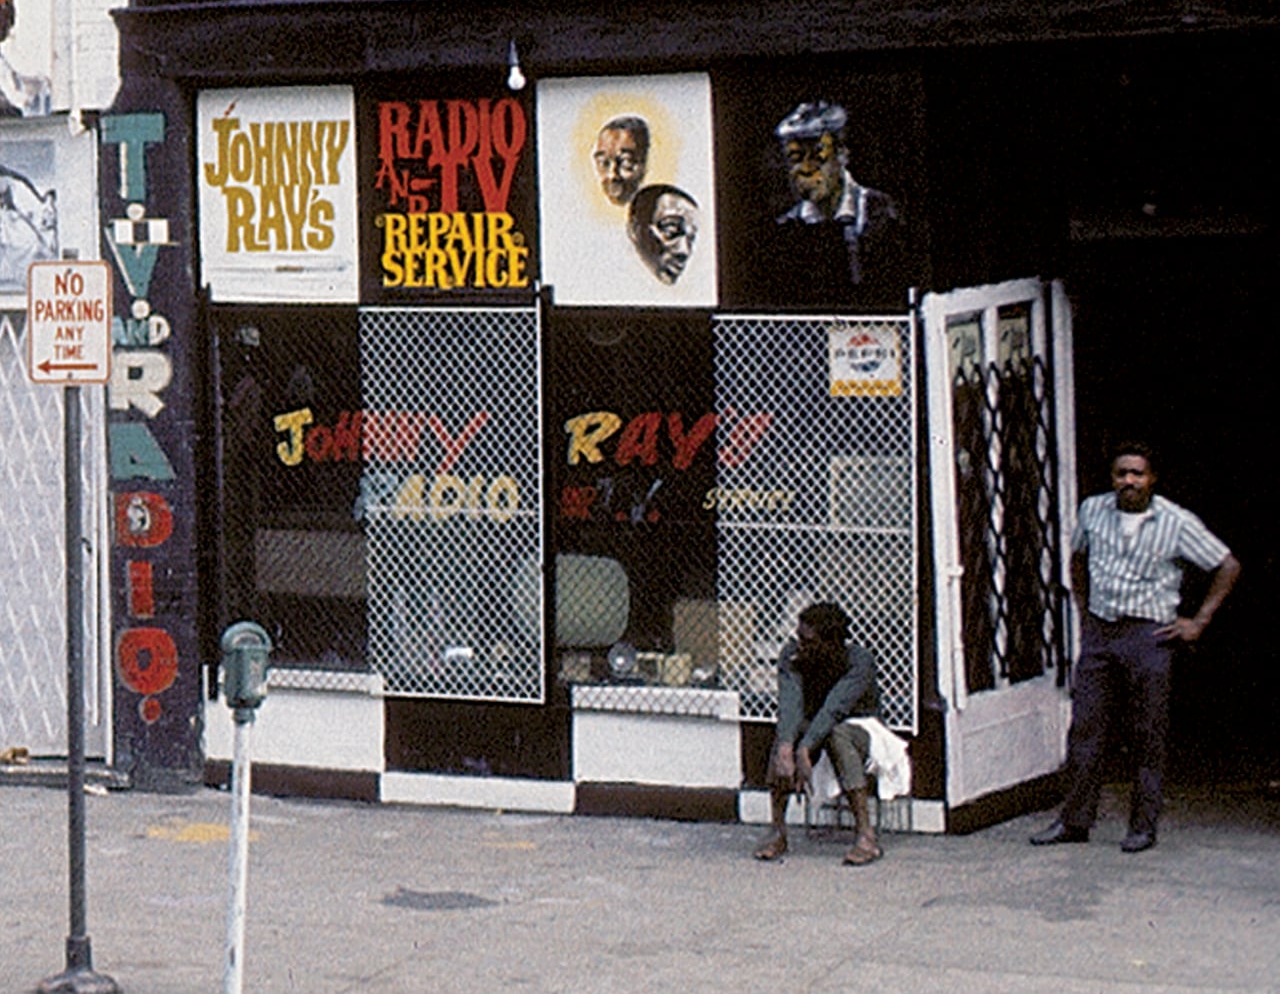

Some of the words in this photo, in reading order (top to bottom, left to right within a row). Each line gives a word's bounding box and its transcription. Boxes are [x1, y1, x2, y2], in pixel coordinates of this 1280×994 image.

[379, 98, 528, 159] RADIO
[203, 117, 350, 188] JOHNNY
[428, 155, 520, 214] TV
[382, 212, 516, 253] REPAIR
[54, 273, 84, 296] NO
[381, 249, 529, 290] SERVICE
[35, 300, 105, 323] PARKING
[112, 314, 171, 346] AND
[54, 344, 84, 360] TIME
[55, 326, 84, 342] ANY
[353, 471, 519, 523] RADIO
